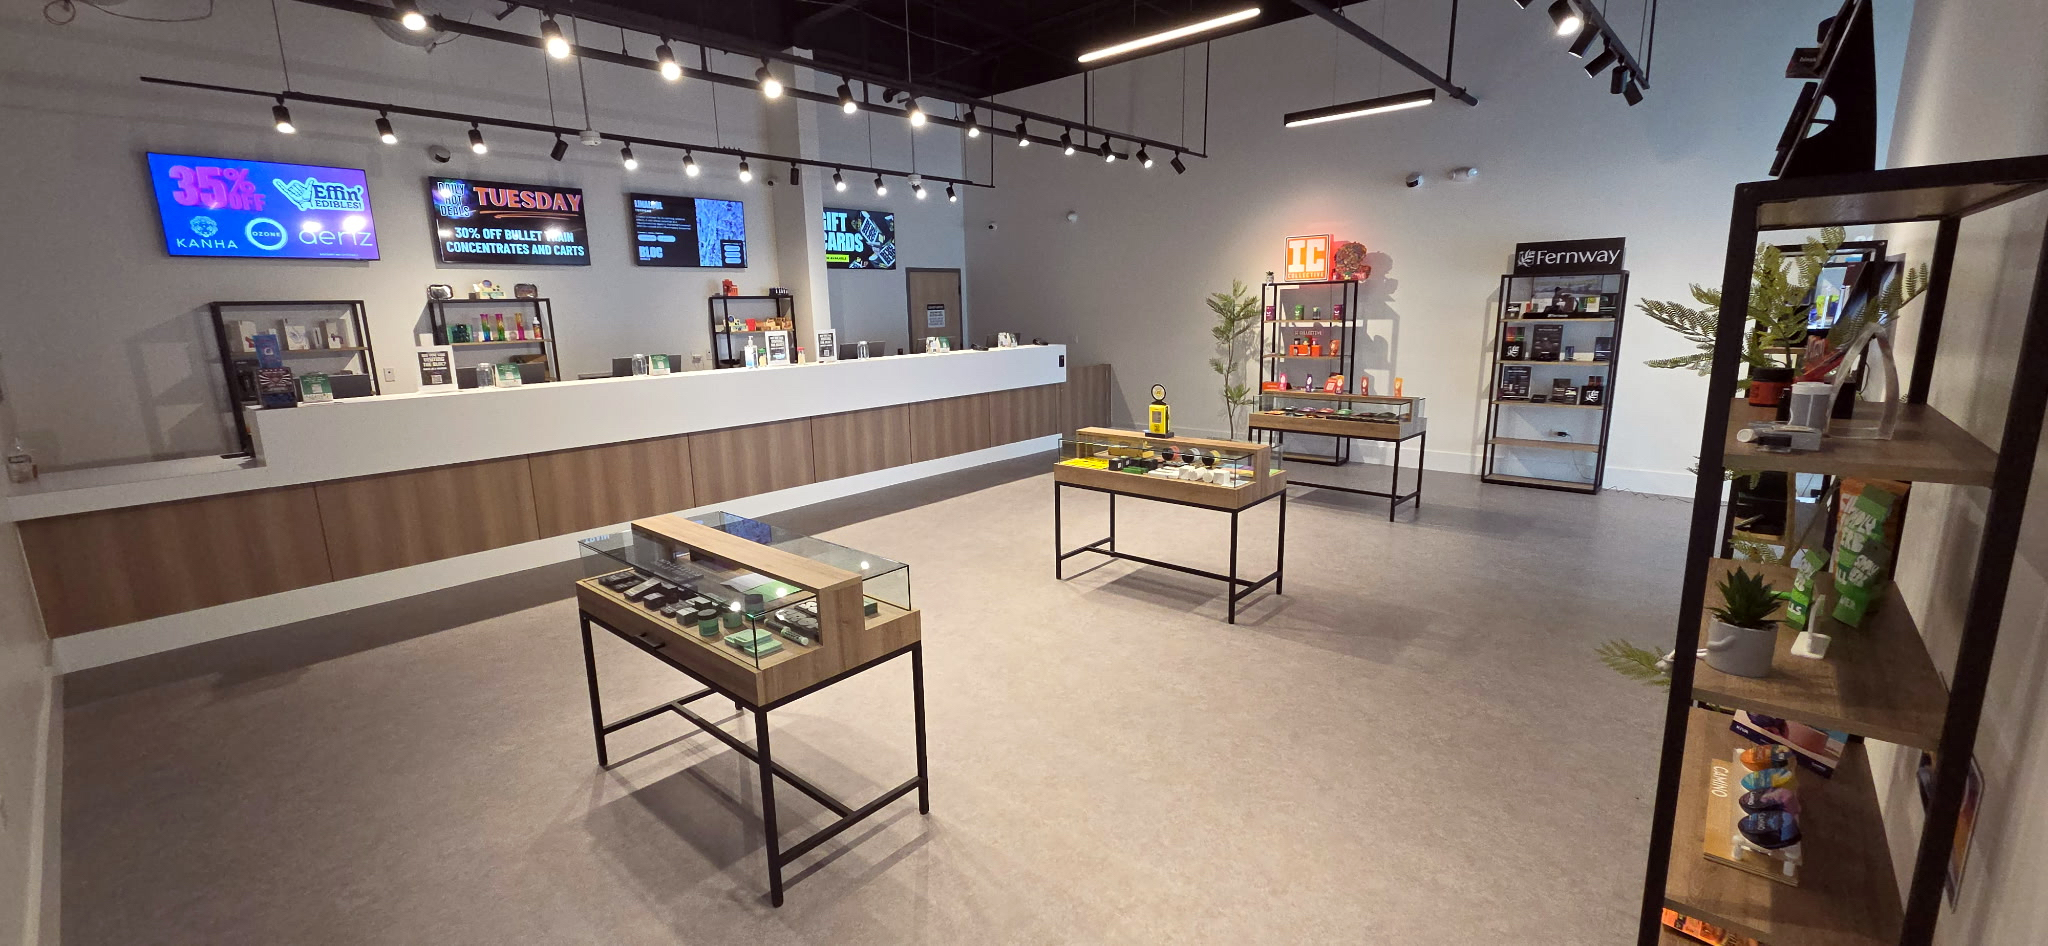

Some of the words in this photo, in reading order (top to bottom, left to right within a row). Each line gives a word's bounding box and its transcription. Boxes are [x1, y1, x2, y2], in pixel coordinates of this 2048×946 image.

[169, 165, 256, 209] 35%
[314, 184, 363, 201] Effin'
[230, 193, 265, 211] OFF
[315, 200, 362, 209] EDIBLES!
[473, 187, 581, 211] TUESDAY
[440, 205, 470, 217] DEALS
[455, 227, 480, 239] 30%
[483, 228, 502, 240] OFF
[505, 229, 542, 241] BULLET
[176, 238, 238, 249] KANHA
[446, 242, 530, 255] CONCENTRATES
[531, 245, 551, 255] AND
[554, 245, 585, 256] CARTS
[1288, 238, 1326, 273] IC
[1536, 249, 1620, 265] Fernway
[1712, 766, 1729, 798] CAMINO
